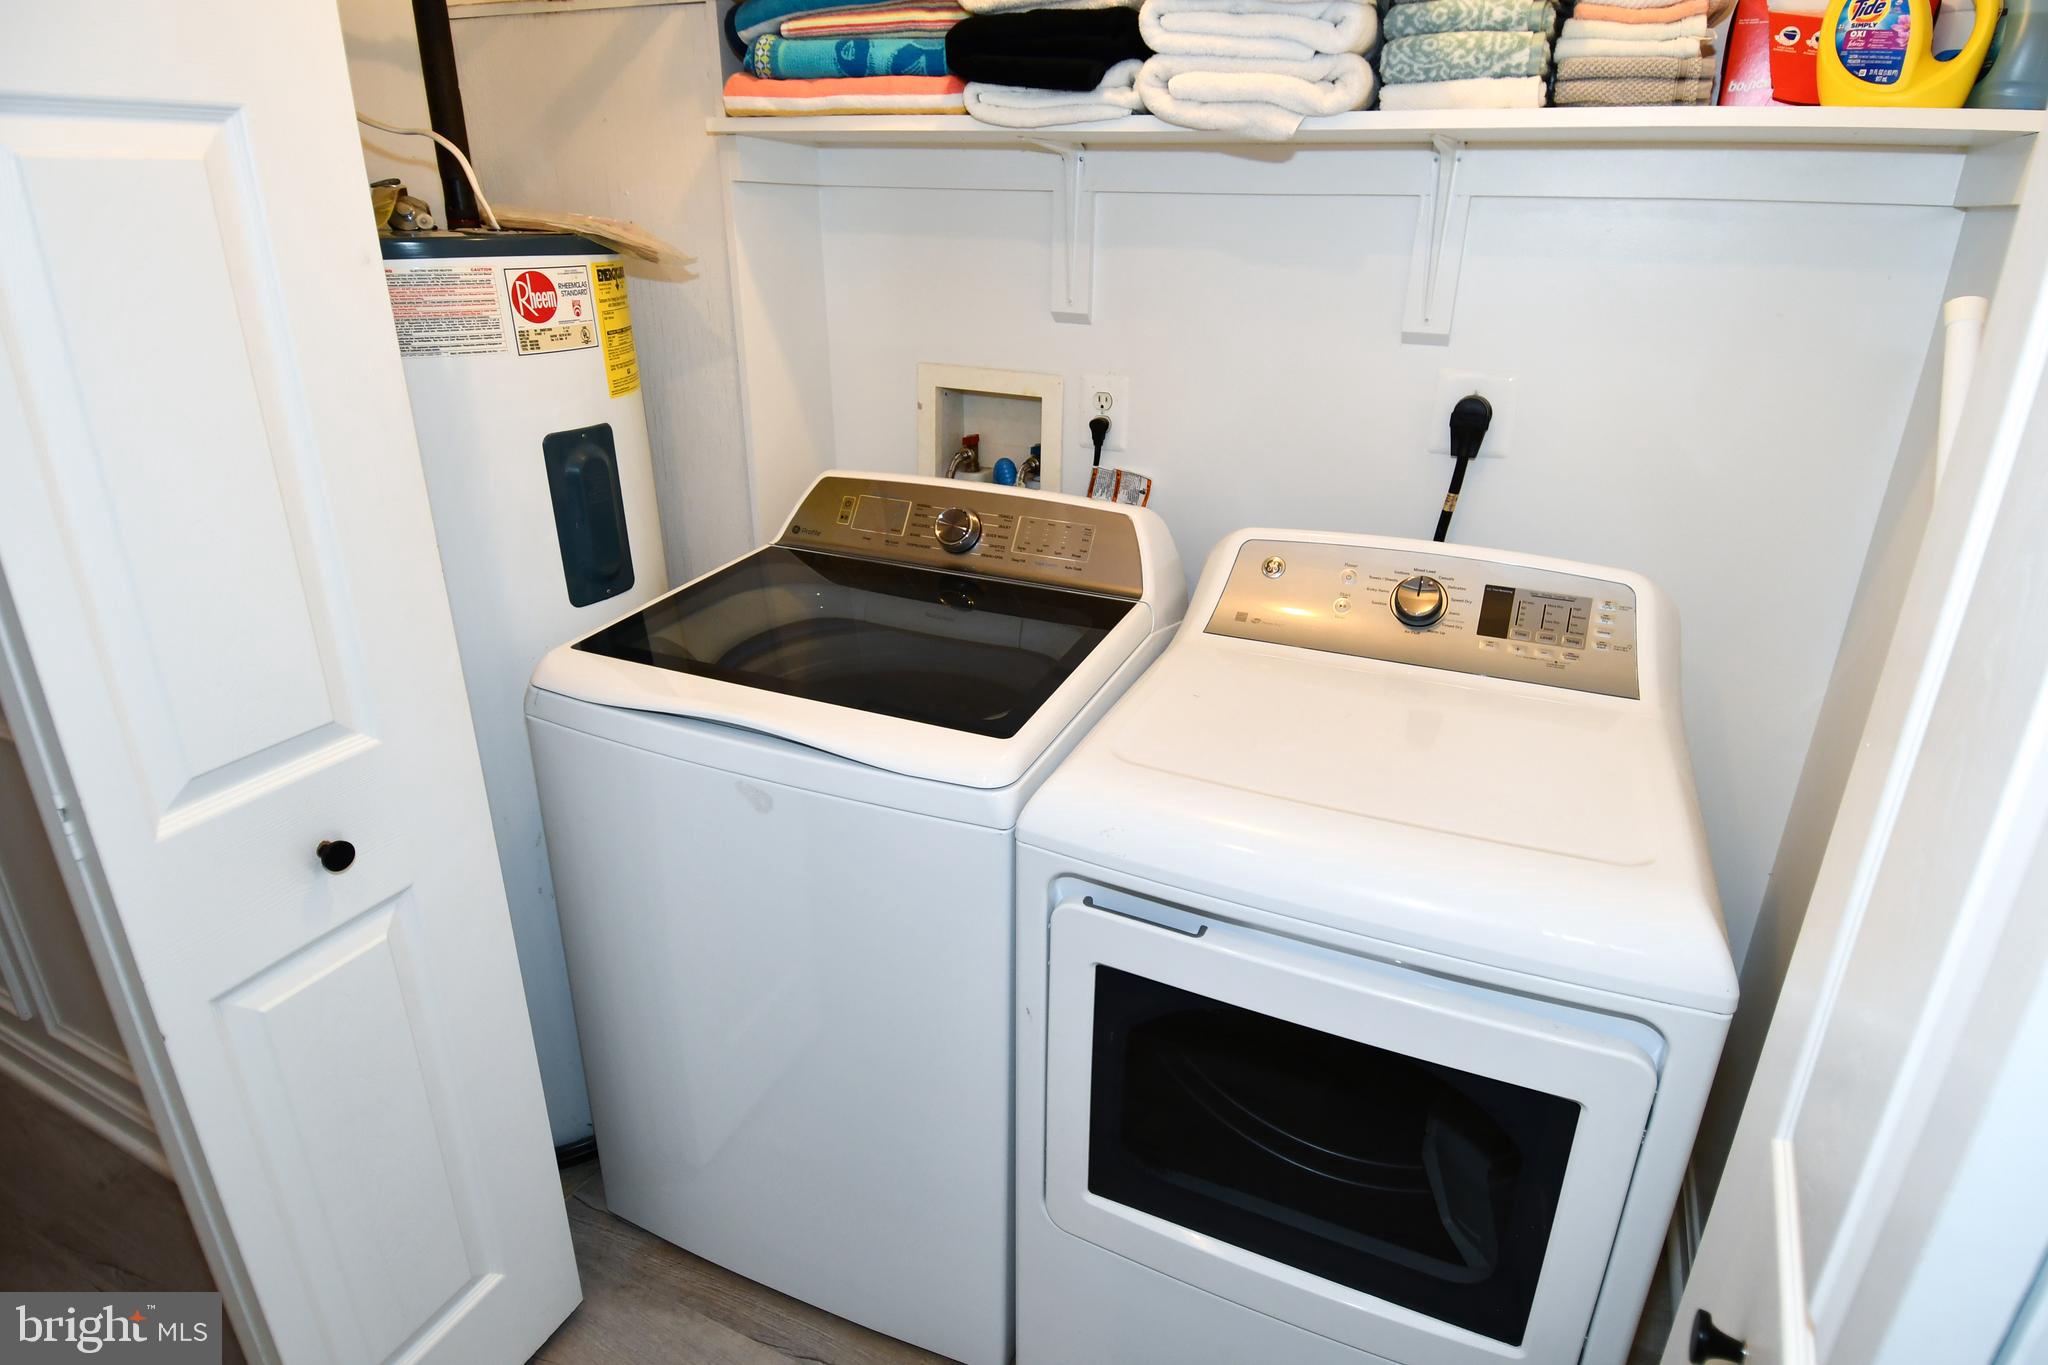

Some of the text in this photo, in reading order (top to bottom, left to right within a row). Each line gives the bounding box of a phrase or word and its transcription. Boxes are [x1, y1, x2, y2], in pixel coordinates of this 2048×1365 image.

[1851, 0, 1887, 20] Tide
[1850, 30, 1867, 38] OXI
[515, 273, 557, 317] Rheem
[561, 288, 588, 297] STANDARD
